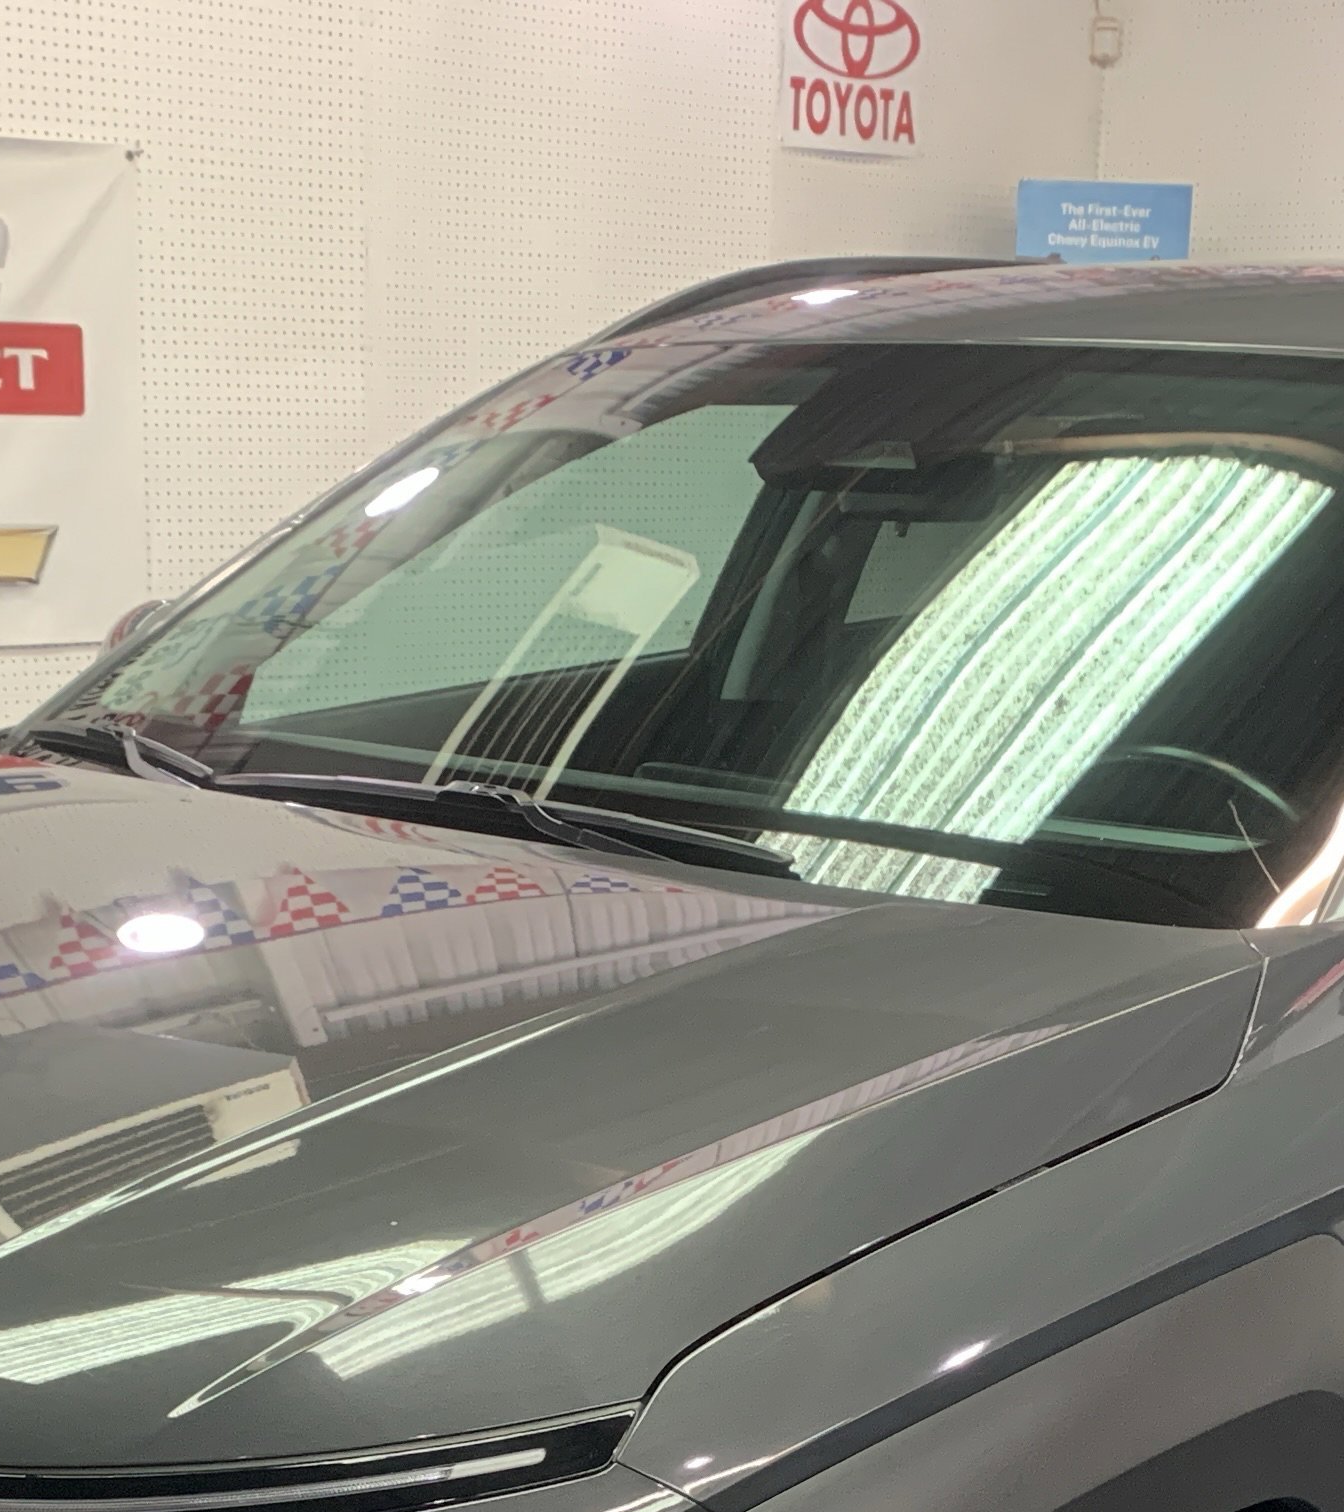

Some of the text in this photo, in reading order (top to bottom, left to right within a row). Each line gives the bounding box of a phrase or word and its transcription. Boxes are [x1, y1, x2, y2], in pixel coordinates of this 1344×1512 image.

[790, 76, 916, 145] TOYOTA
[1060, 202, 1151, 218] The First-Ever
[1068, 219, 1141, 233] All-Electric
[1047, 233, 1160, 249] Chevy Equinox EV
